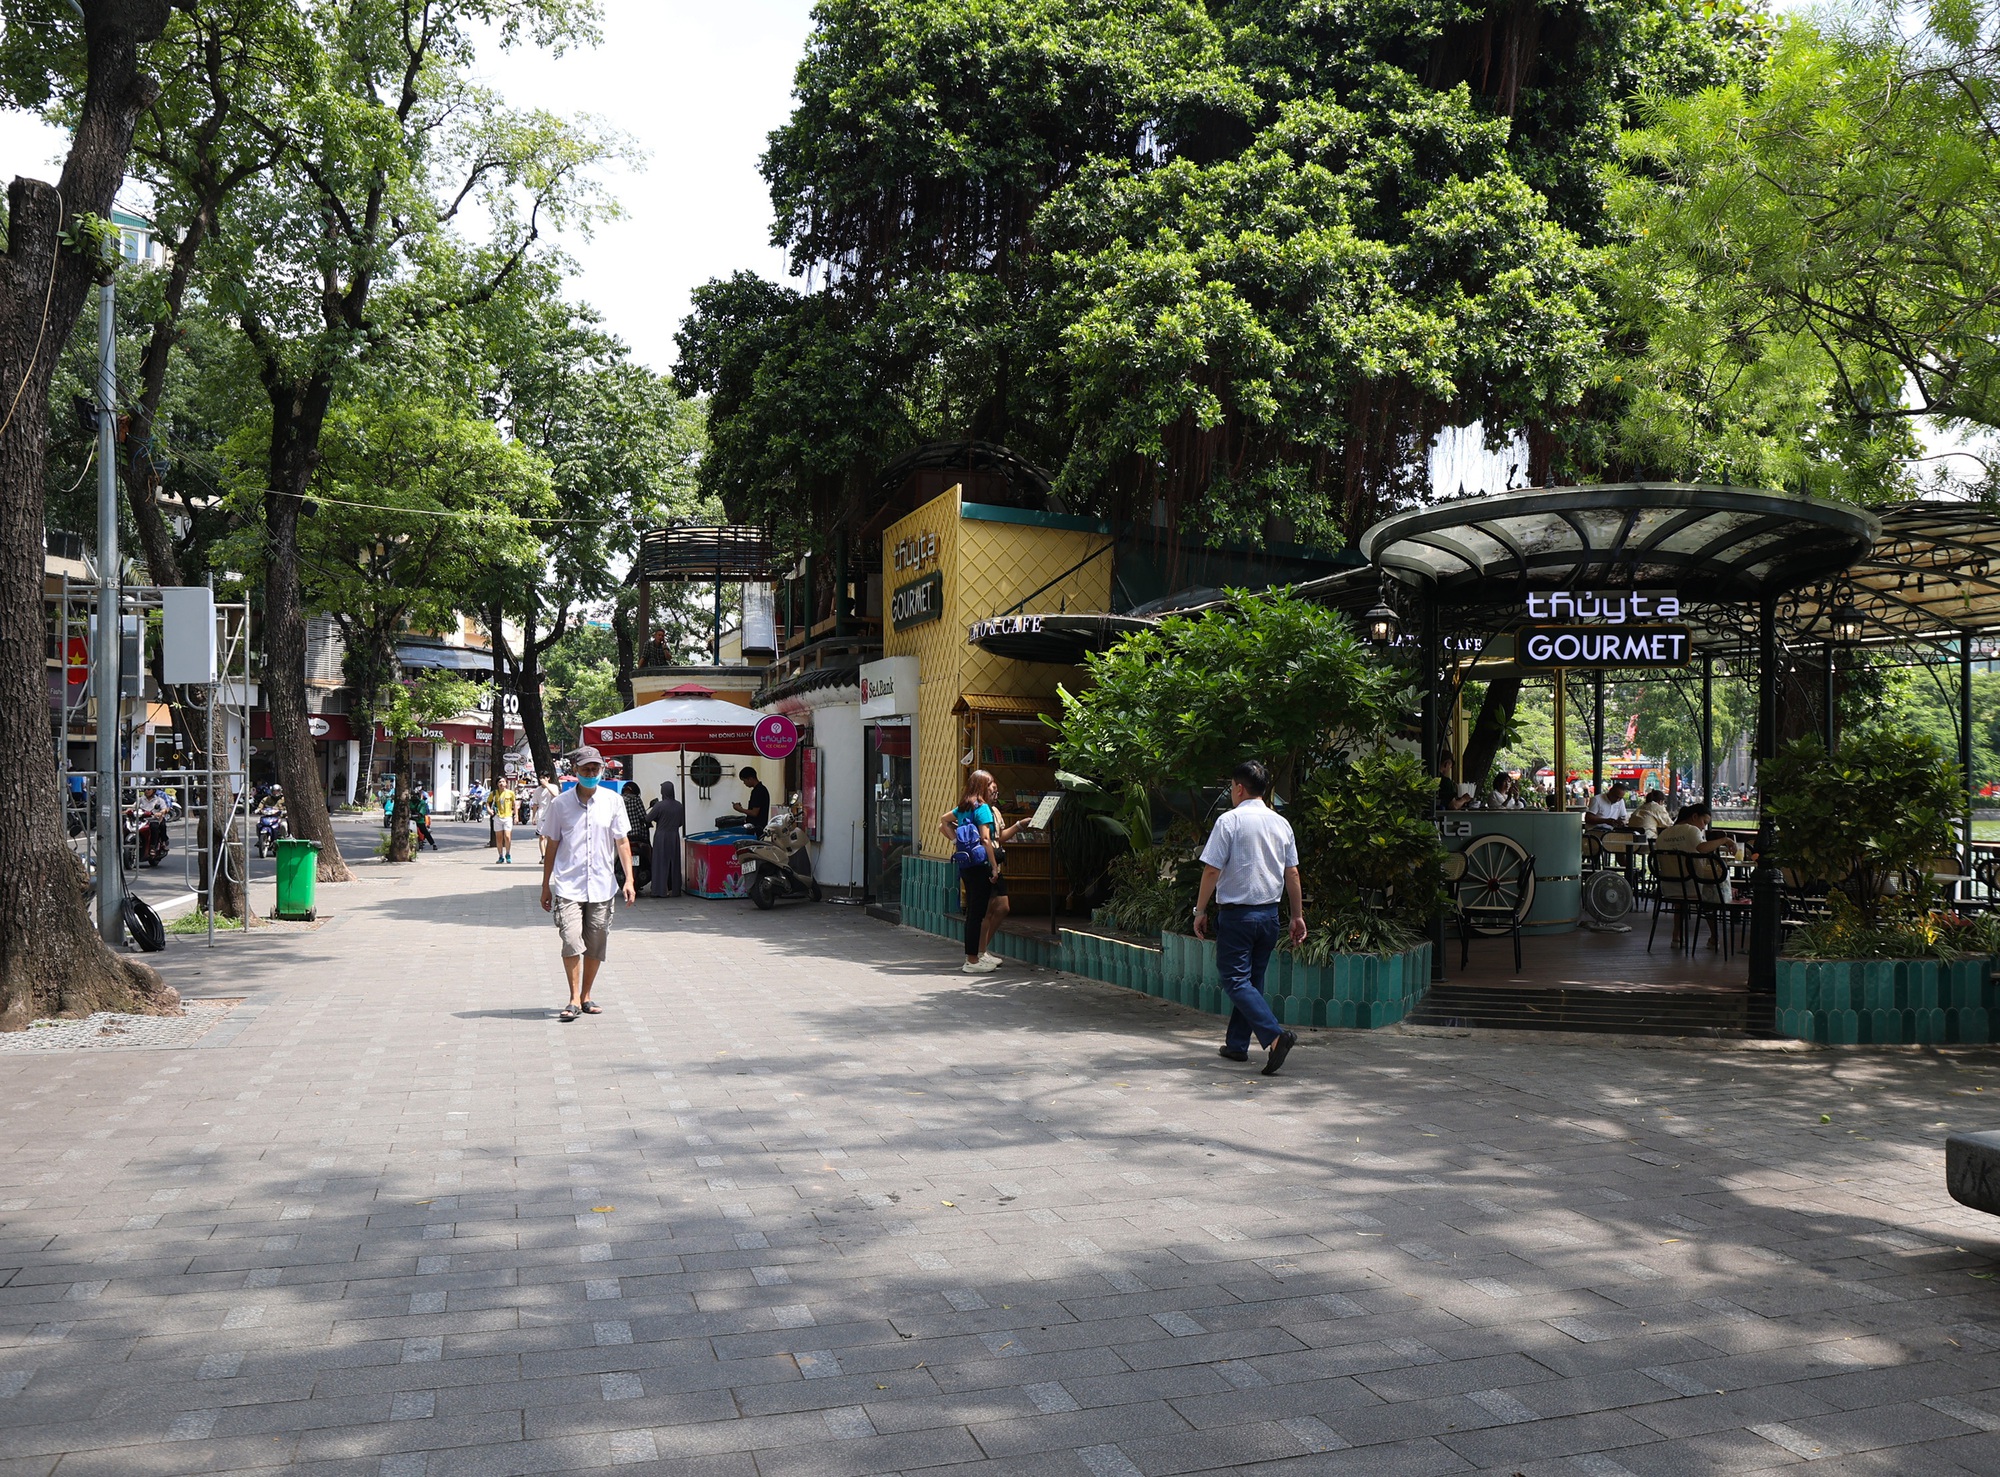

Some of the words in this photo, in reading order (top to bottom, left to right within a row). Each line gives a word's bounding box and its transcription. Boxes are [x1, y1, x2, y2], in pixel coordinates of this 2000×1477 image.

[892, 581, 934, 623] GOURMET
[989, 619, 998, 636] &
[1527, 634, 1686, 661] GOURMET
[868, 676, 894, 698] SeABank
[614, 731, 655, 740] SeABank
